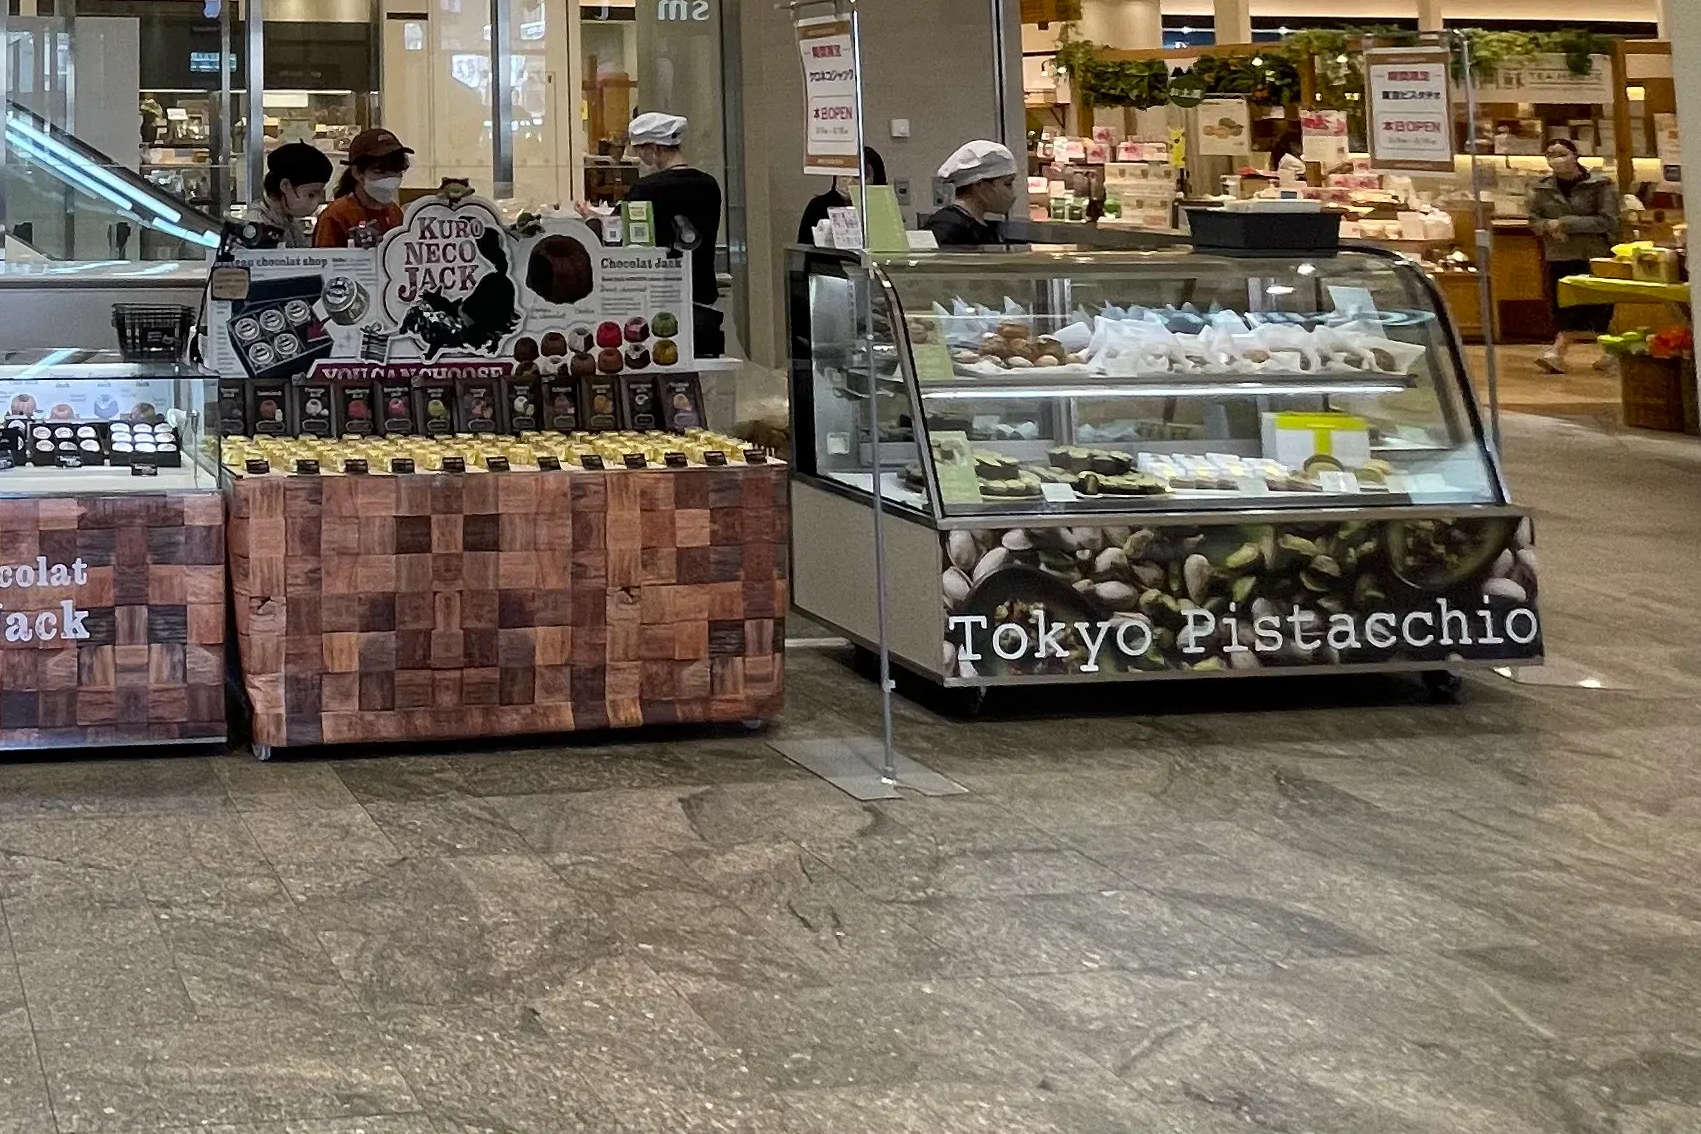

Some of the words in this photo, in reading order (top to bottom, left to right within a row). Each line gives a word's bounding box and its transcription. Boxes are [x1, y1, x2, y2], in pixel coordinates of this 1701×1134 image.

[813, 106, 853, 120] 本日OPEN
[417, 216, 485, 240] KURO
[256, 255, 301, 267] chocolat
[303, 255, 328, 269] shop
[403, 240, 477, 266] NECO
[600, 257, 652, 270] Chocolat
[397, 265, 480, 302] JACK
[948, 609, 1153, 673] Tokyo
[1180, 595, 1538, 655] Pistacchio
